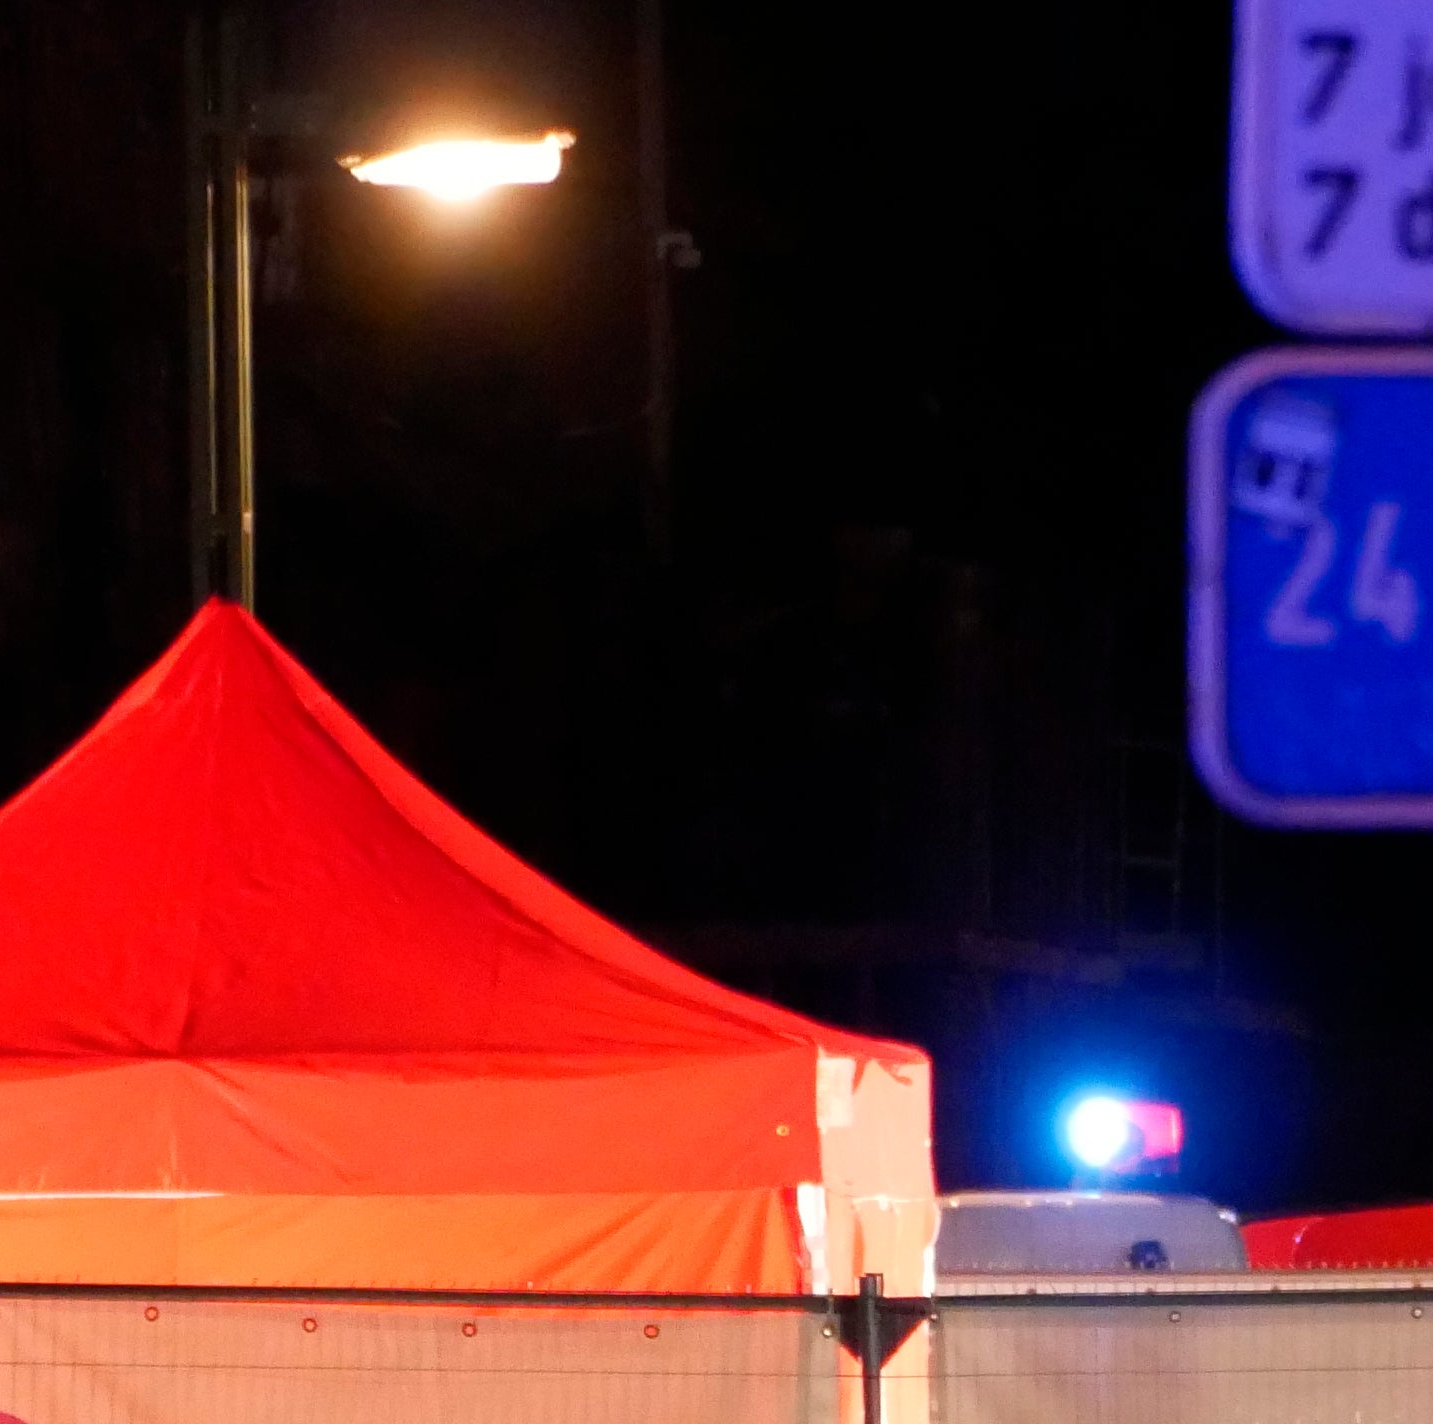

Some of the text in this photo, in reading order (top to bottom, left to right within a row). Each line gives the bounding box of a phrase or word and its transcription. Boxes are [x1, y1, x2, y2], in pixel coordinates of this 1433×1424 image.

[1297, 33, 1358, 127] 7
[1301, 165, 1359, 258] 7
[1264, 500, 1420, 645] 24
